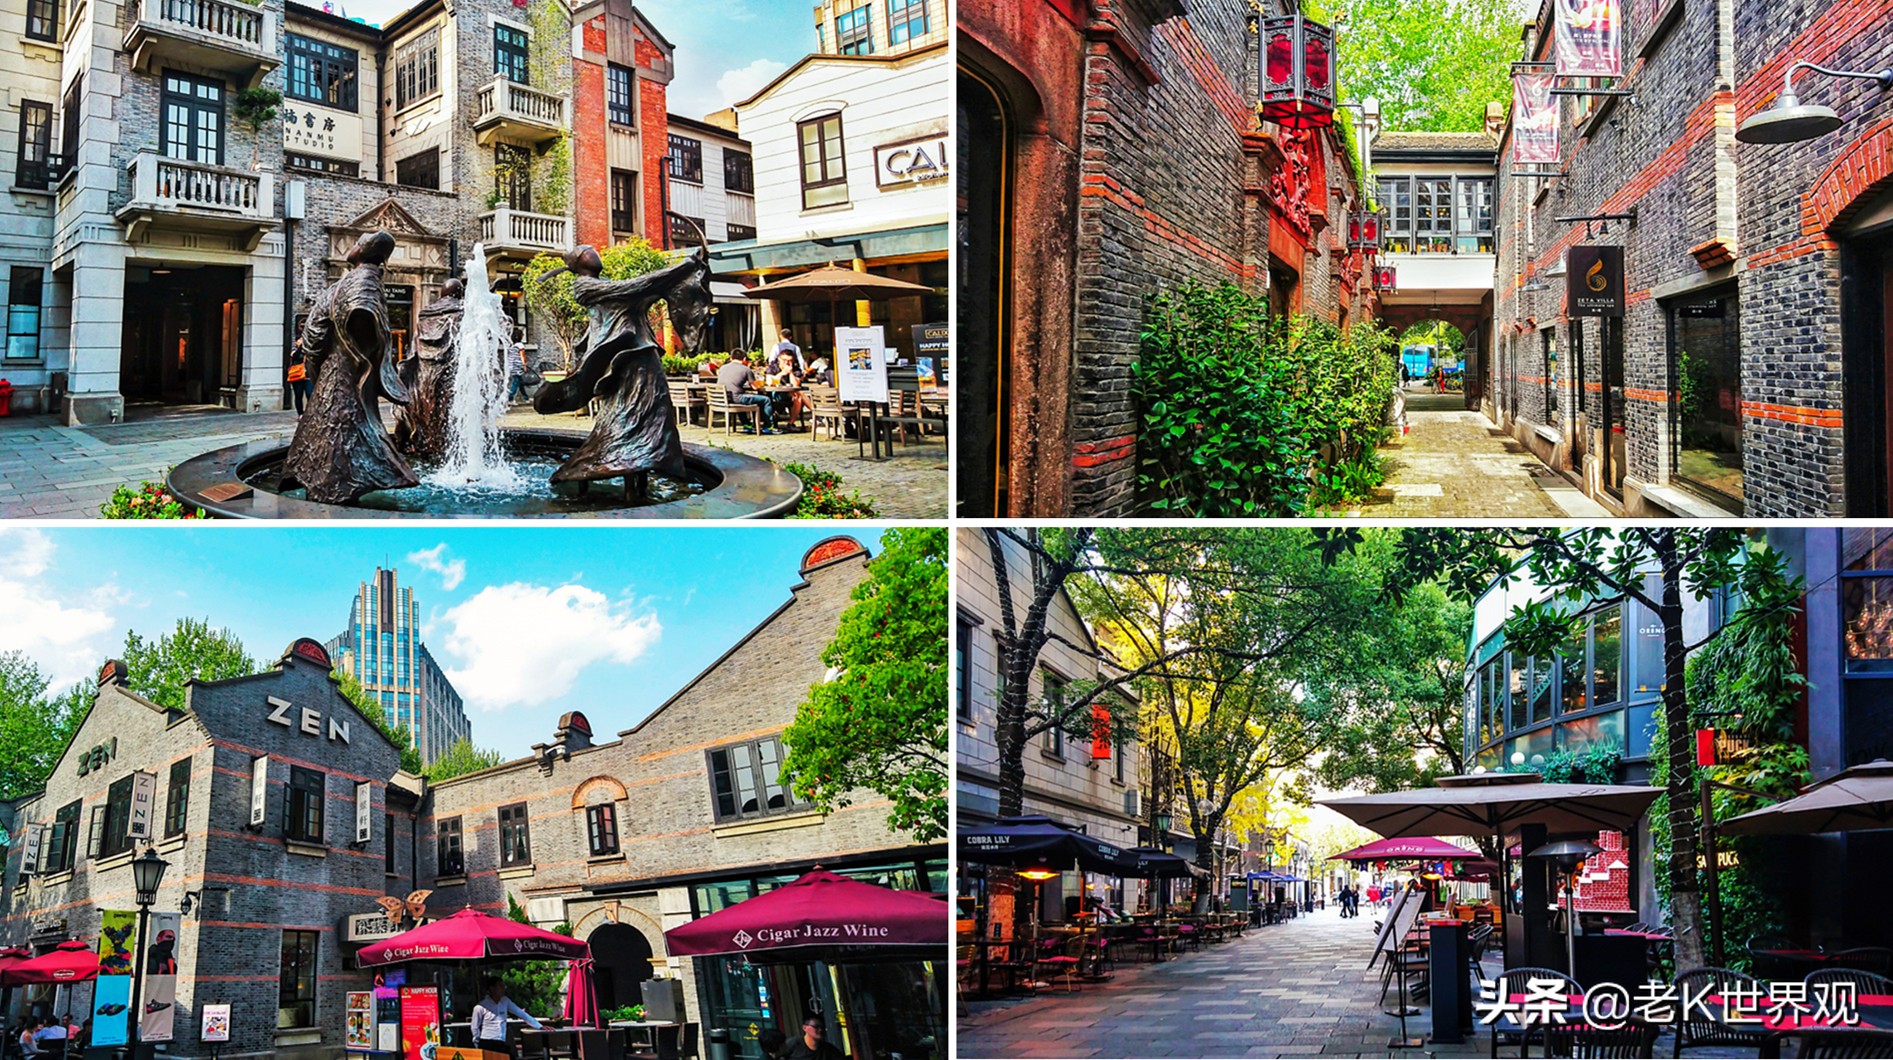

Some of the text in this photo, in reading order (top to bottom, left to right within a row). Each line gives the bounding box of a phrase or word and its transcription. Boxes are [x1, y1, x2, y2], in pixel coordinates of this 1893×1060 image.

[285, 127, 334, 143] NANMU
[285, 135, 334, 150] STUDIO
[267, 695, 350, 745] ZEN
[77, 737, 117, 778] ZEN
[135, 777, 149, 819] ZEN
[27, 827, 39, 859] ZEN
[967, 835, 1010, 844] COBRA LILY
[1717, 851, 1740, 867] PUCK
[757, 924, 889, 943] Cigar Jazz Wine
[394, 944, 449, 957] Cigar Jazz Wine
